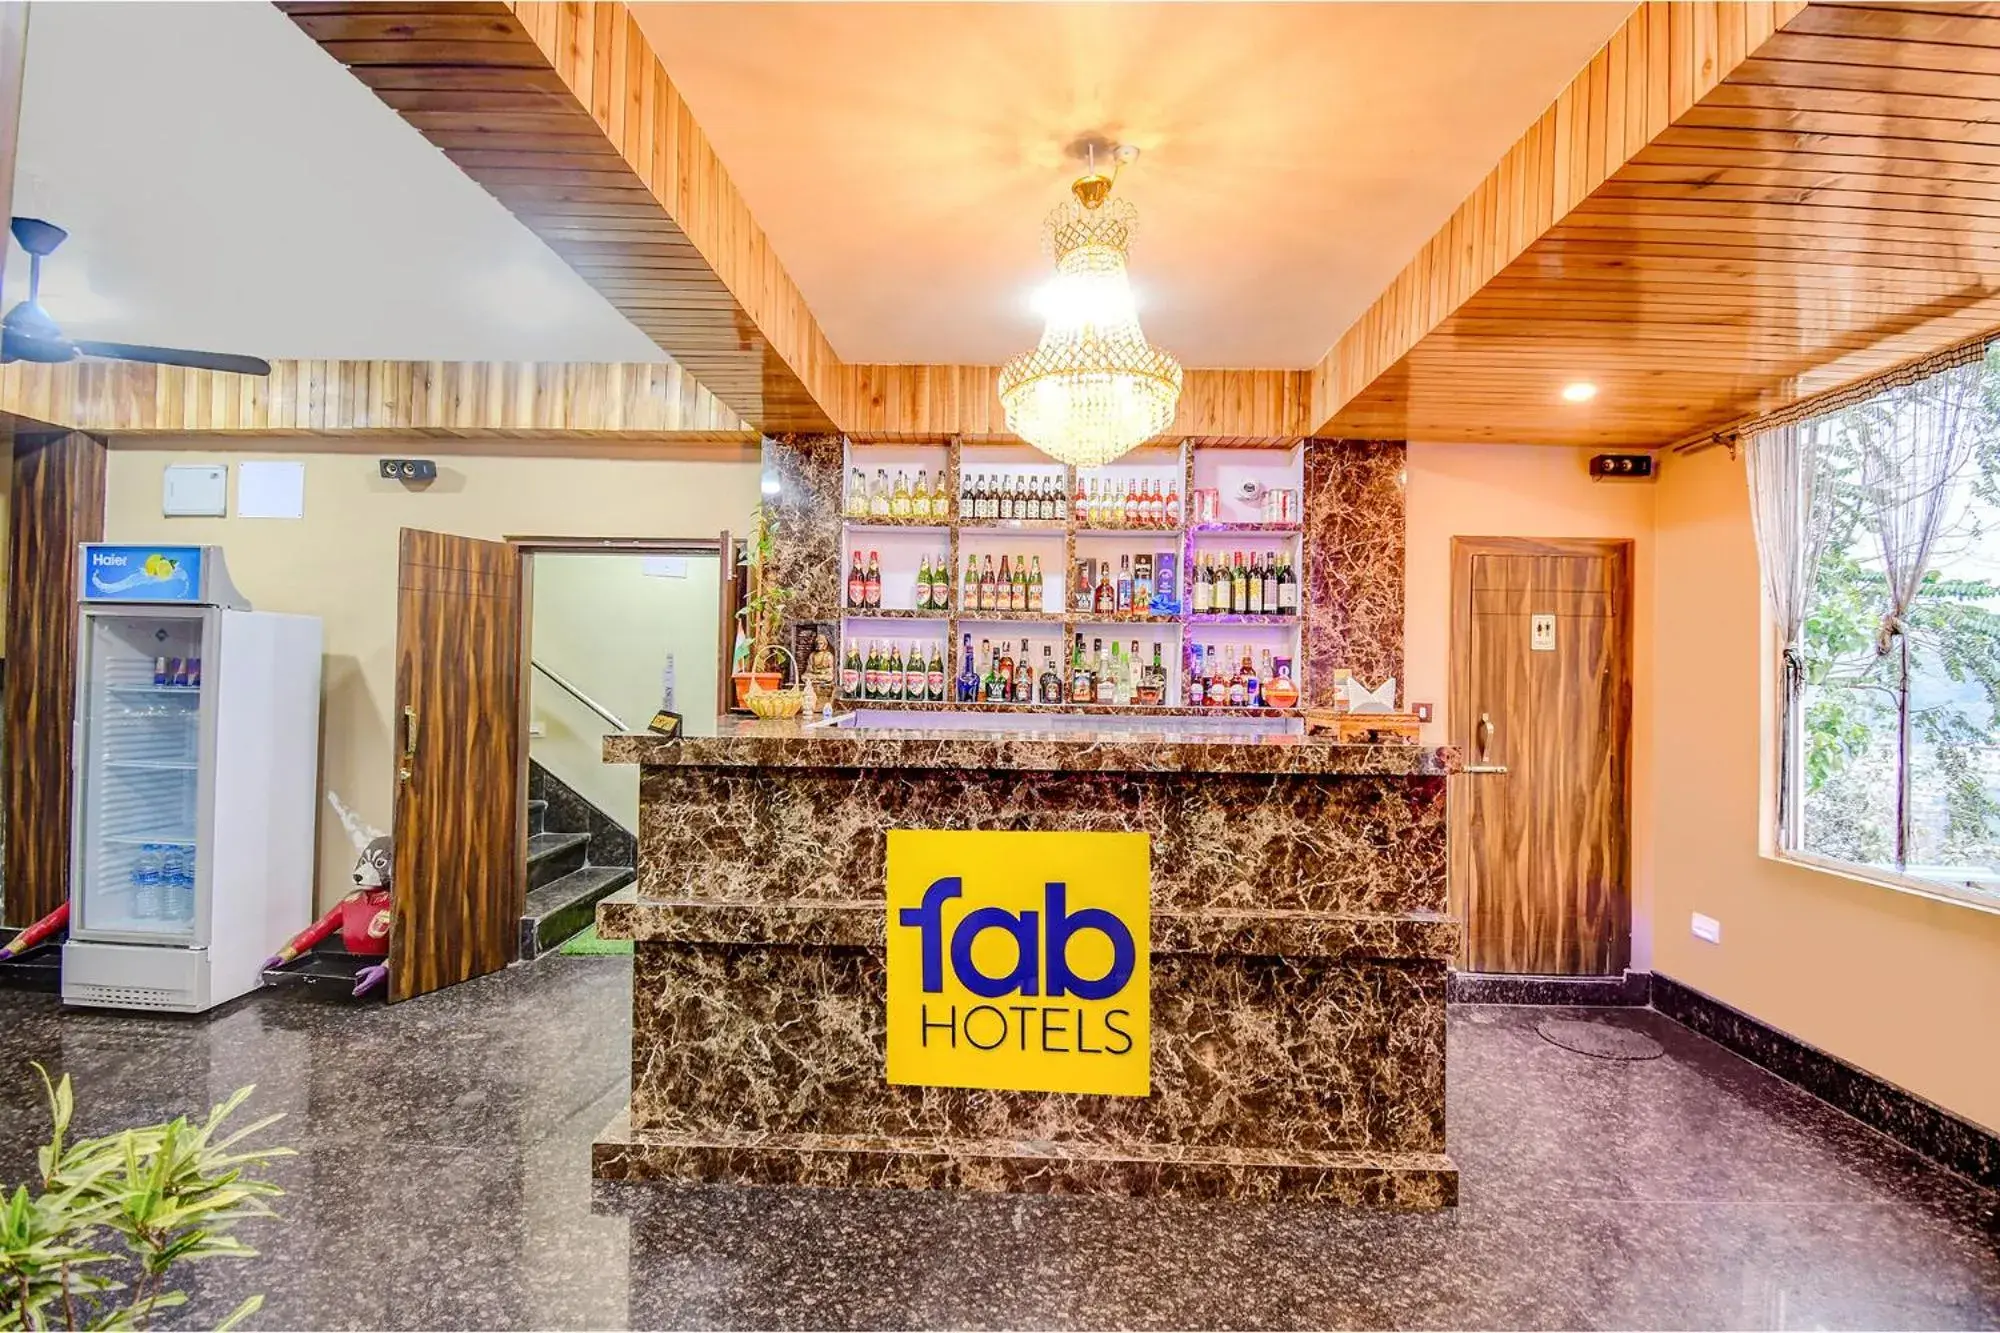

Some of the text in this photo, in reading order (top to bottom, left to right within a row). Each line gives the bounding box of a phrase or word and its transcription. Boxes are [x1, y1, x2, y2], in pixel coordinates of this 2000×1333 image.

[92, 553, 128, 567] Haier
[899, 876, 1136, 1000] fab
[922, 1004, 1133, 1055] HOTELS
